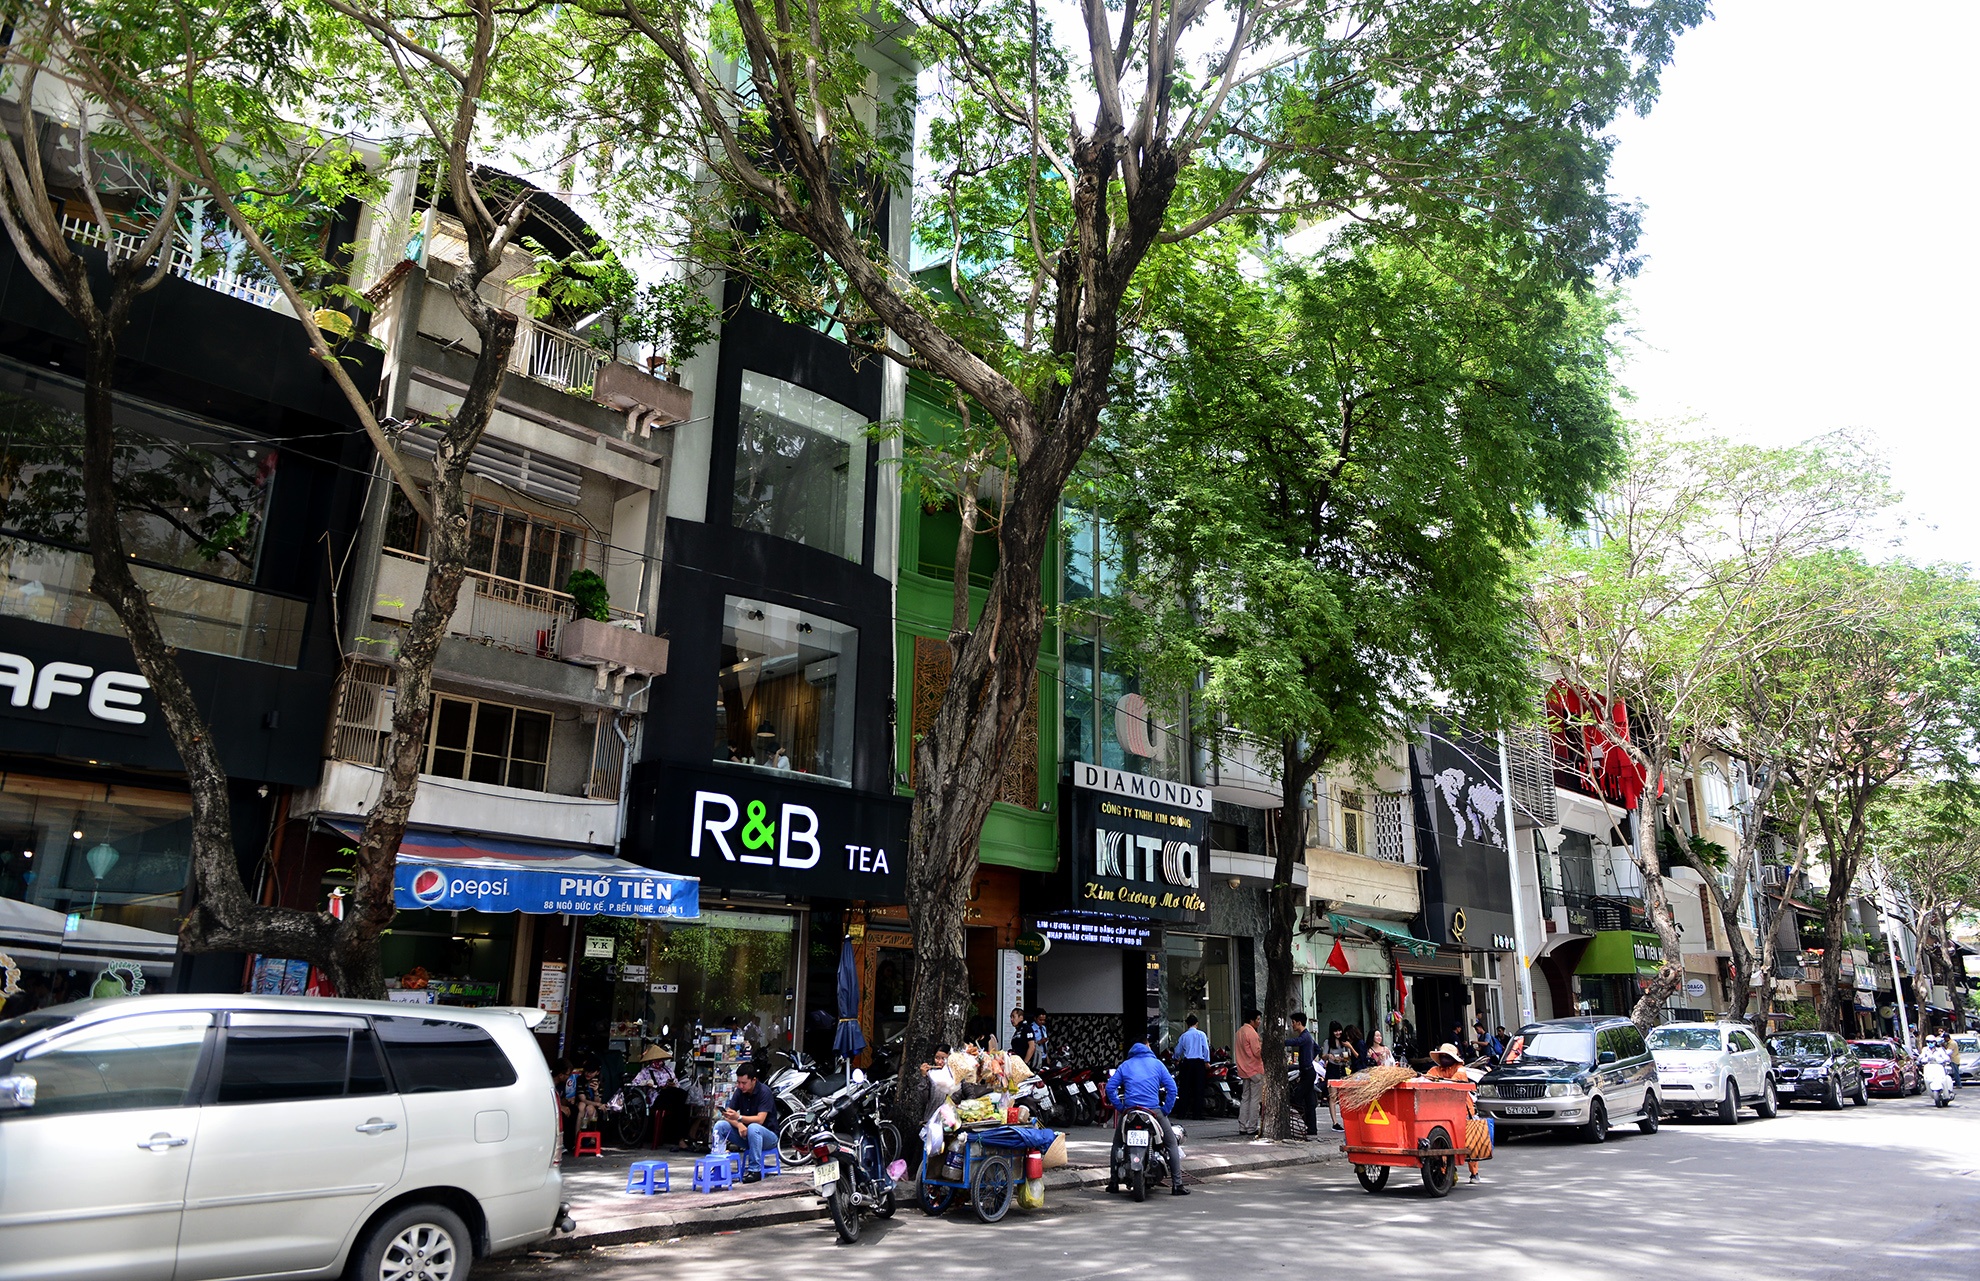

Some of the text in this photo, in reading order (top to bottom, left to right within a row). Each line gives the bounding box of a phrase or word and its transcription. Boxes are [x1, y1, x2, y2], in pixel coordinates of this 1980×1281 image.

[1086, 766, 1204, 808] DIAMONDS
[1101, 801, 1121, 816] CÔNG
[1123, 806, 1132, 818] TY
[1134, 809, 1153, 822] TNHH
[1155, 812, 1168, 824] KIM
[690, 790, 889, 874] R&B TEA
[450, 878, 508, 899] pepsi
[618, 879, 672, 900] TIÊN
[1084, 882, 1115, 901] Kim
[543, 901, 554, 910] 88
[556, 900, 573, 910] NGÔ
[575, 901, 591, 911] ĐỨC
[679, 906, 684, 914] 1
